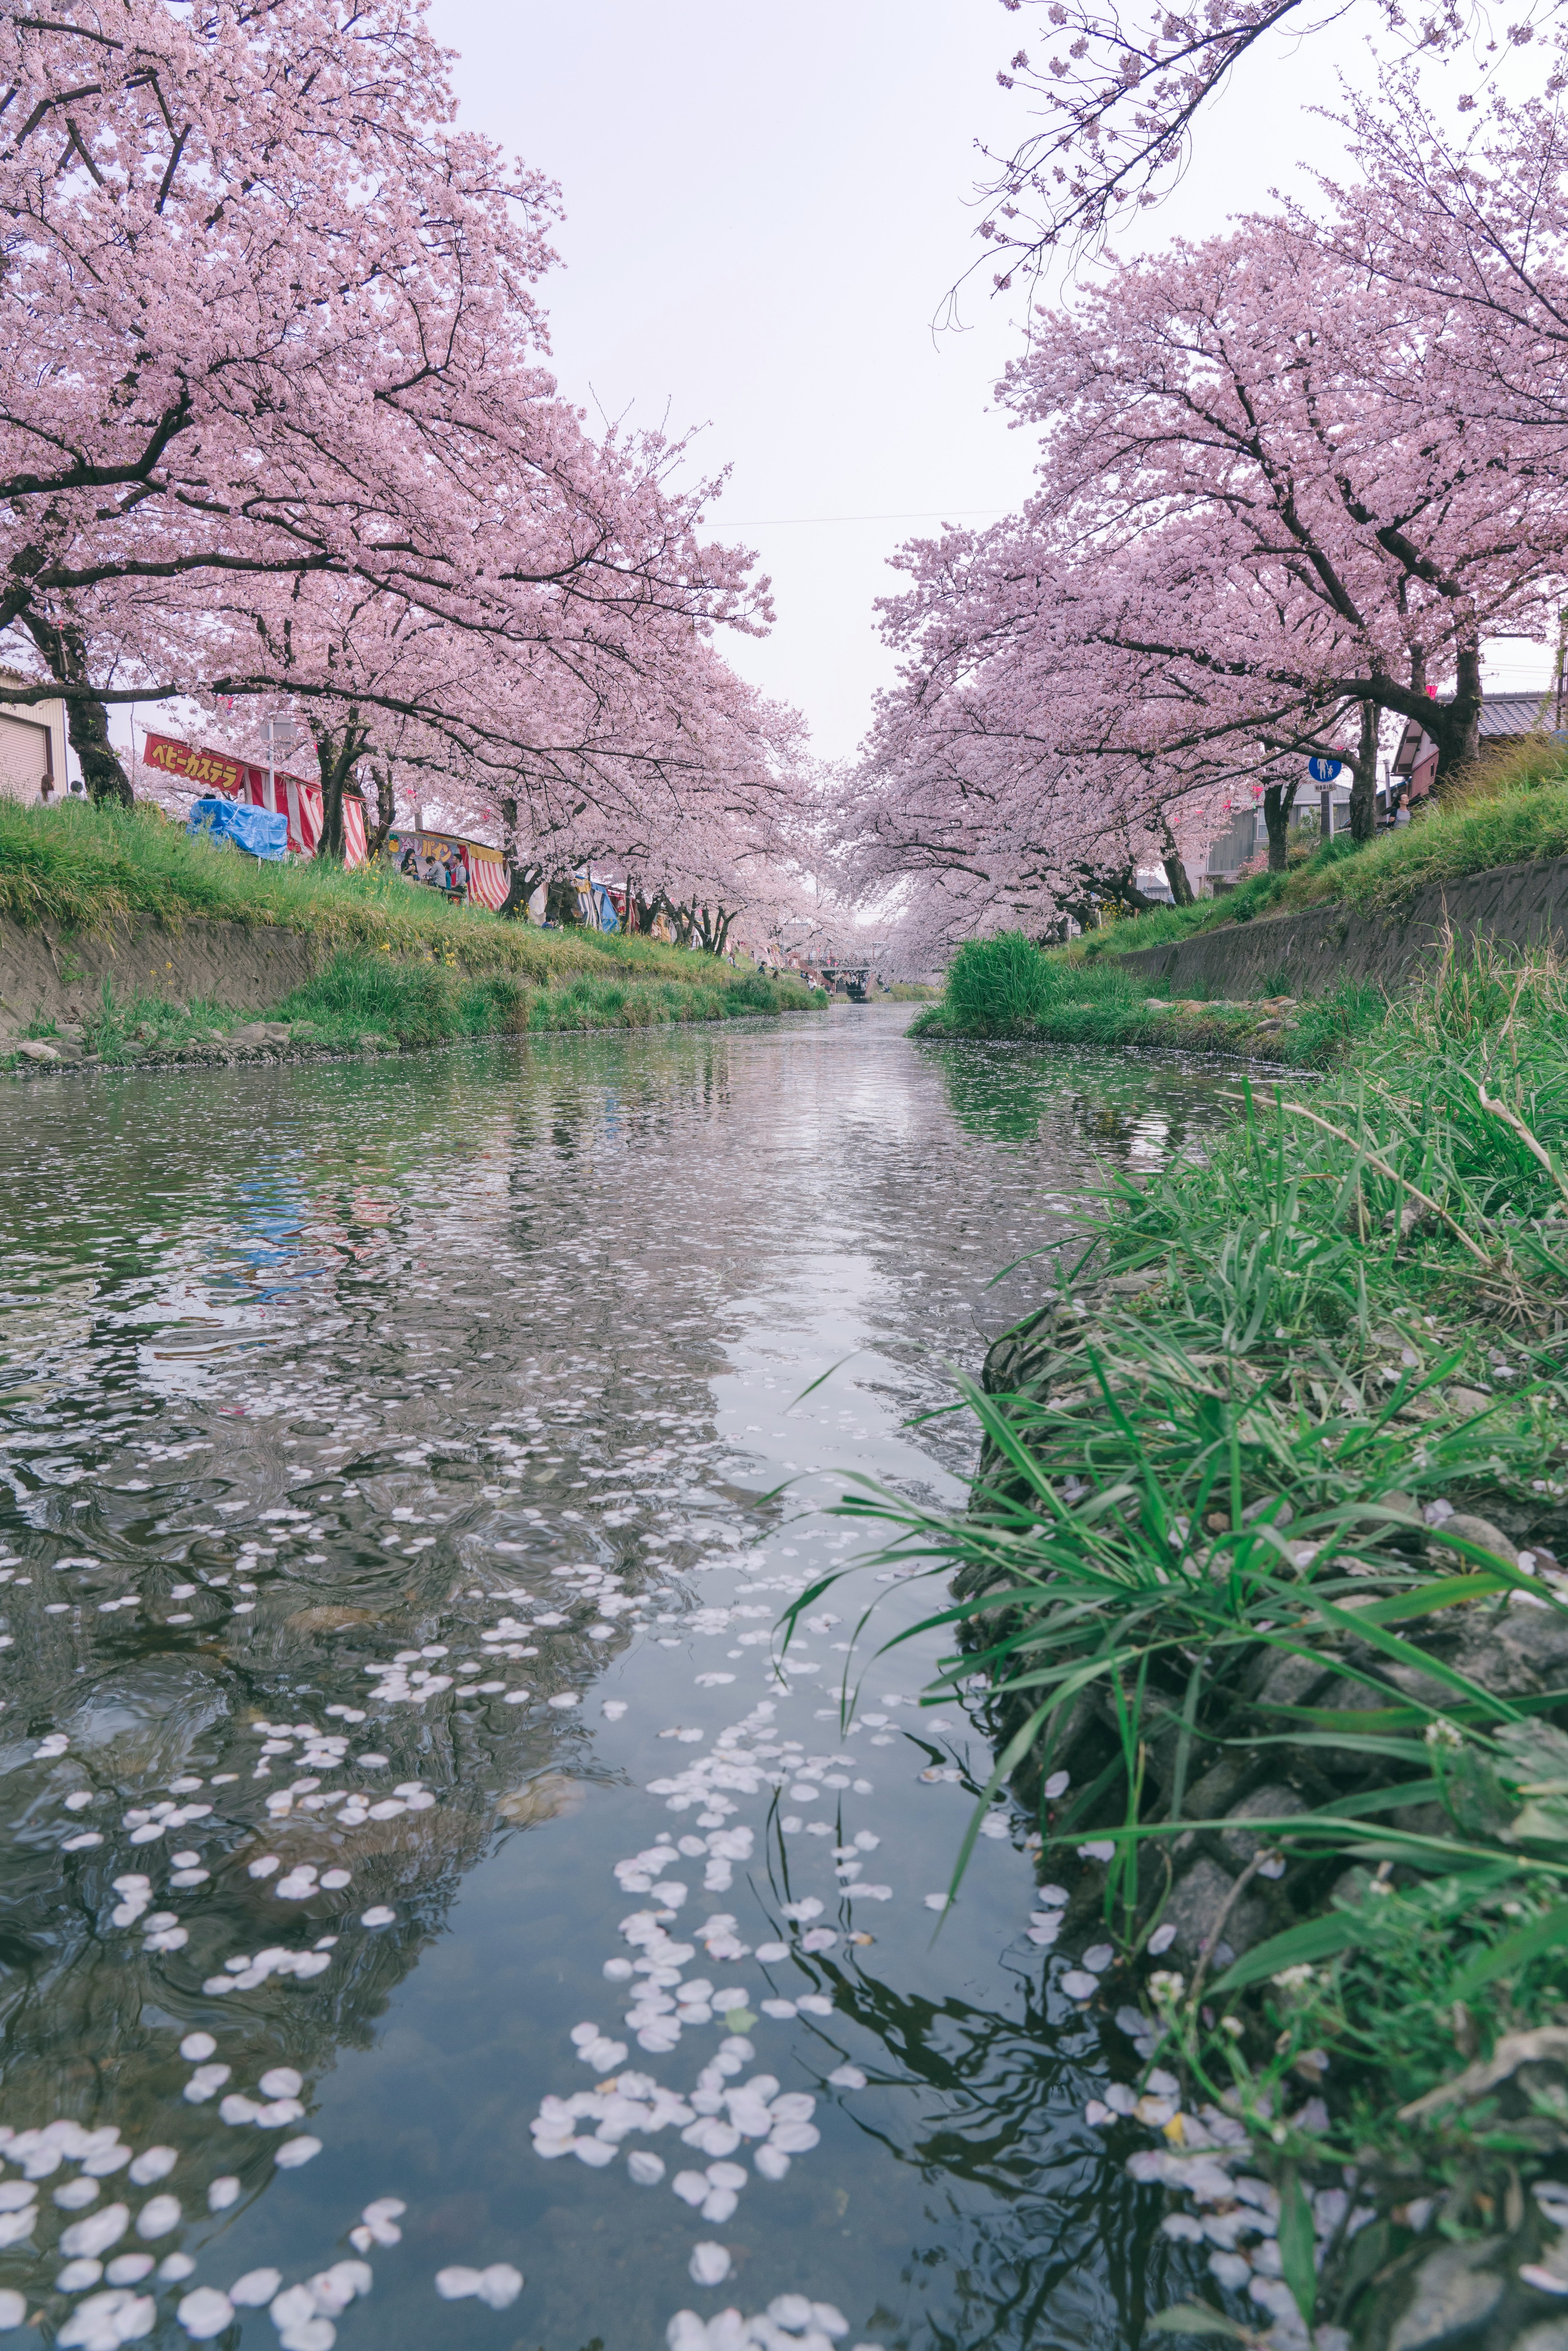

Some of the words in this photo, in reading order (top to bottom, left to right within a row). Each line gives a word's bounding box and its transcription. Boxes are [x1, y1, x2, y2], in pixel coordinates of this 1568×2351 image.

[152, 744, 237, 788] ベビーカステラ
[400, 837, 451, 862] 冷しパイン
